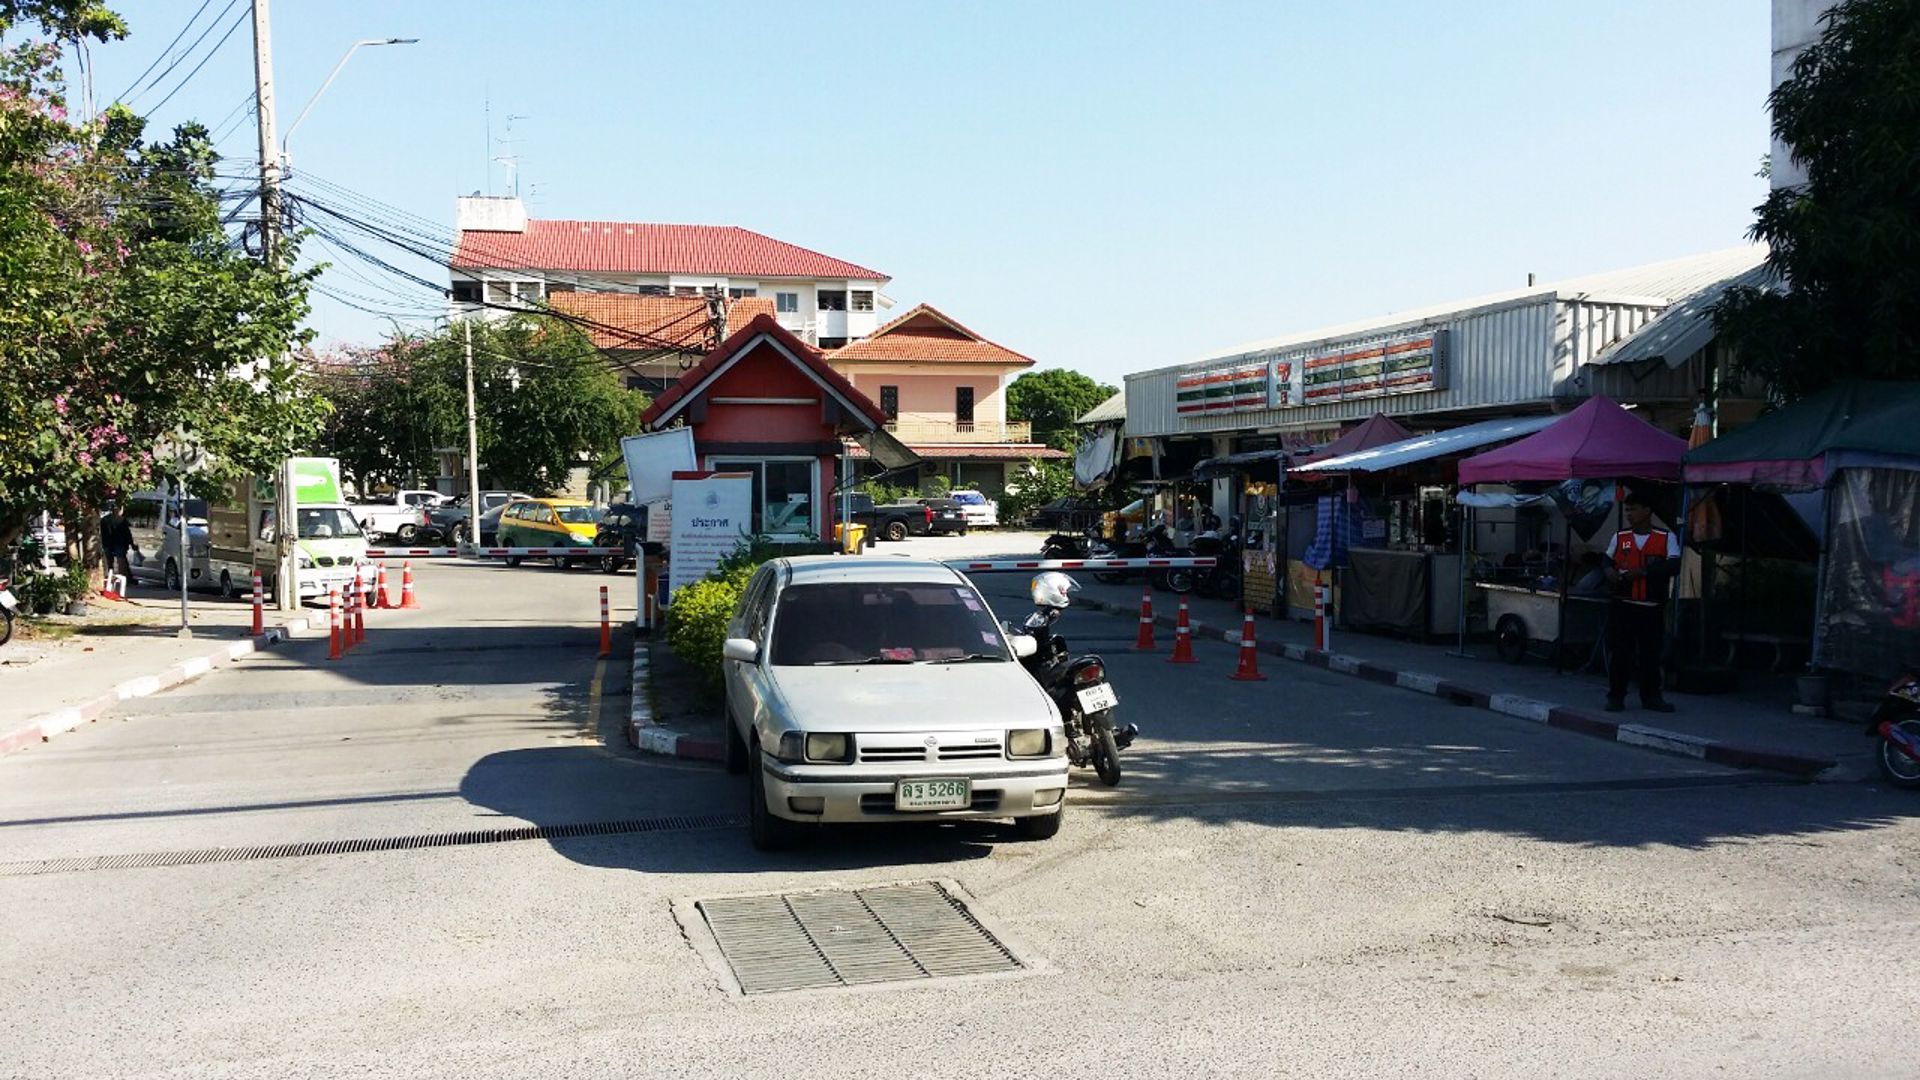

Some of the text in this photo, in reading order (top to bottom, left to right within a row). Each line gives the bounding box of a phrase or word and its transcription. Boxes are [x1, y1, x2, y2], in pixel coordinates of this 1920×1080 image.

[691, 517, 729, 528] ประกาศ
[928, 782, 965, 798] 5266
